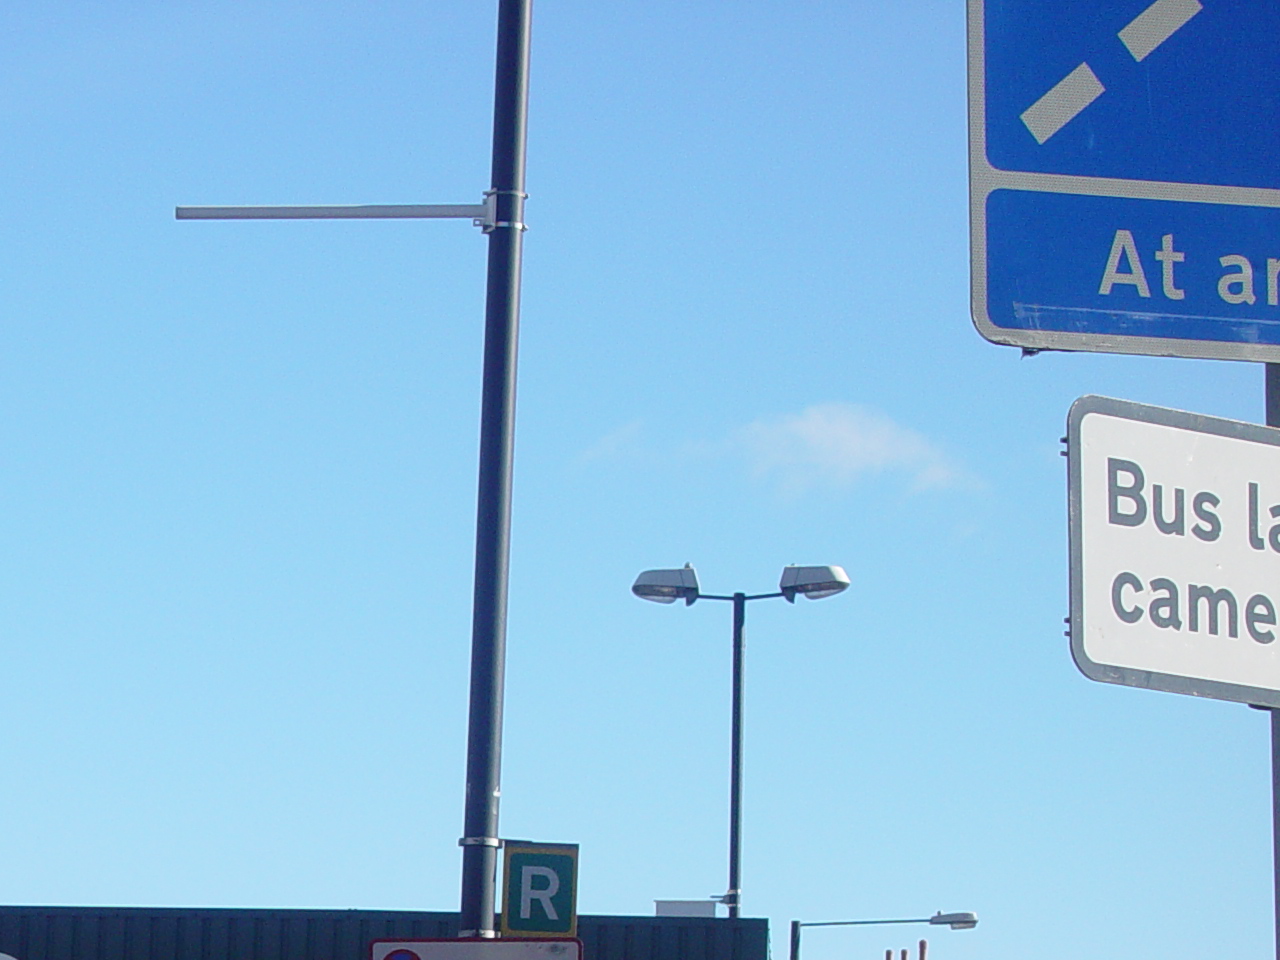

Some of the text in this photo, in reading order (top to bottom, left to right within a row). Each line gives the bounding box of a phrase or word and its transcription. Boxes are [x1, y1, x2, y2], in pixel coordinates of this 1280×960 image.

[1098, 229, 1185, 300] At
[1107, 456, 1222, 543] Bus
[1111, 571, 1277, 645] came
[520, 865, 560, 920] R
